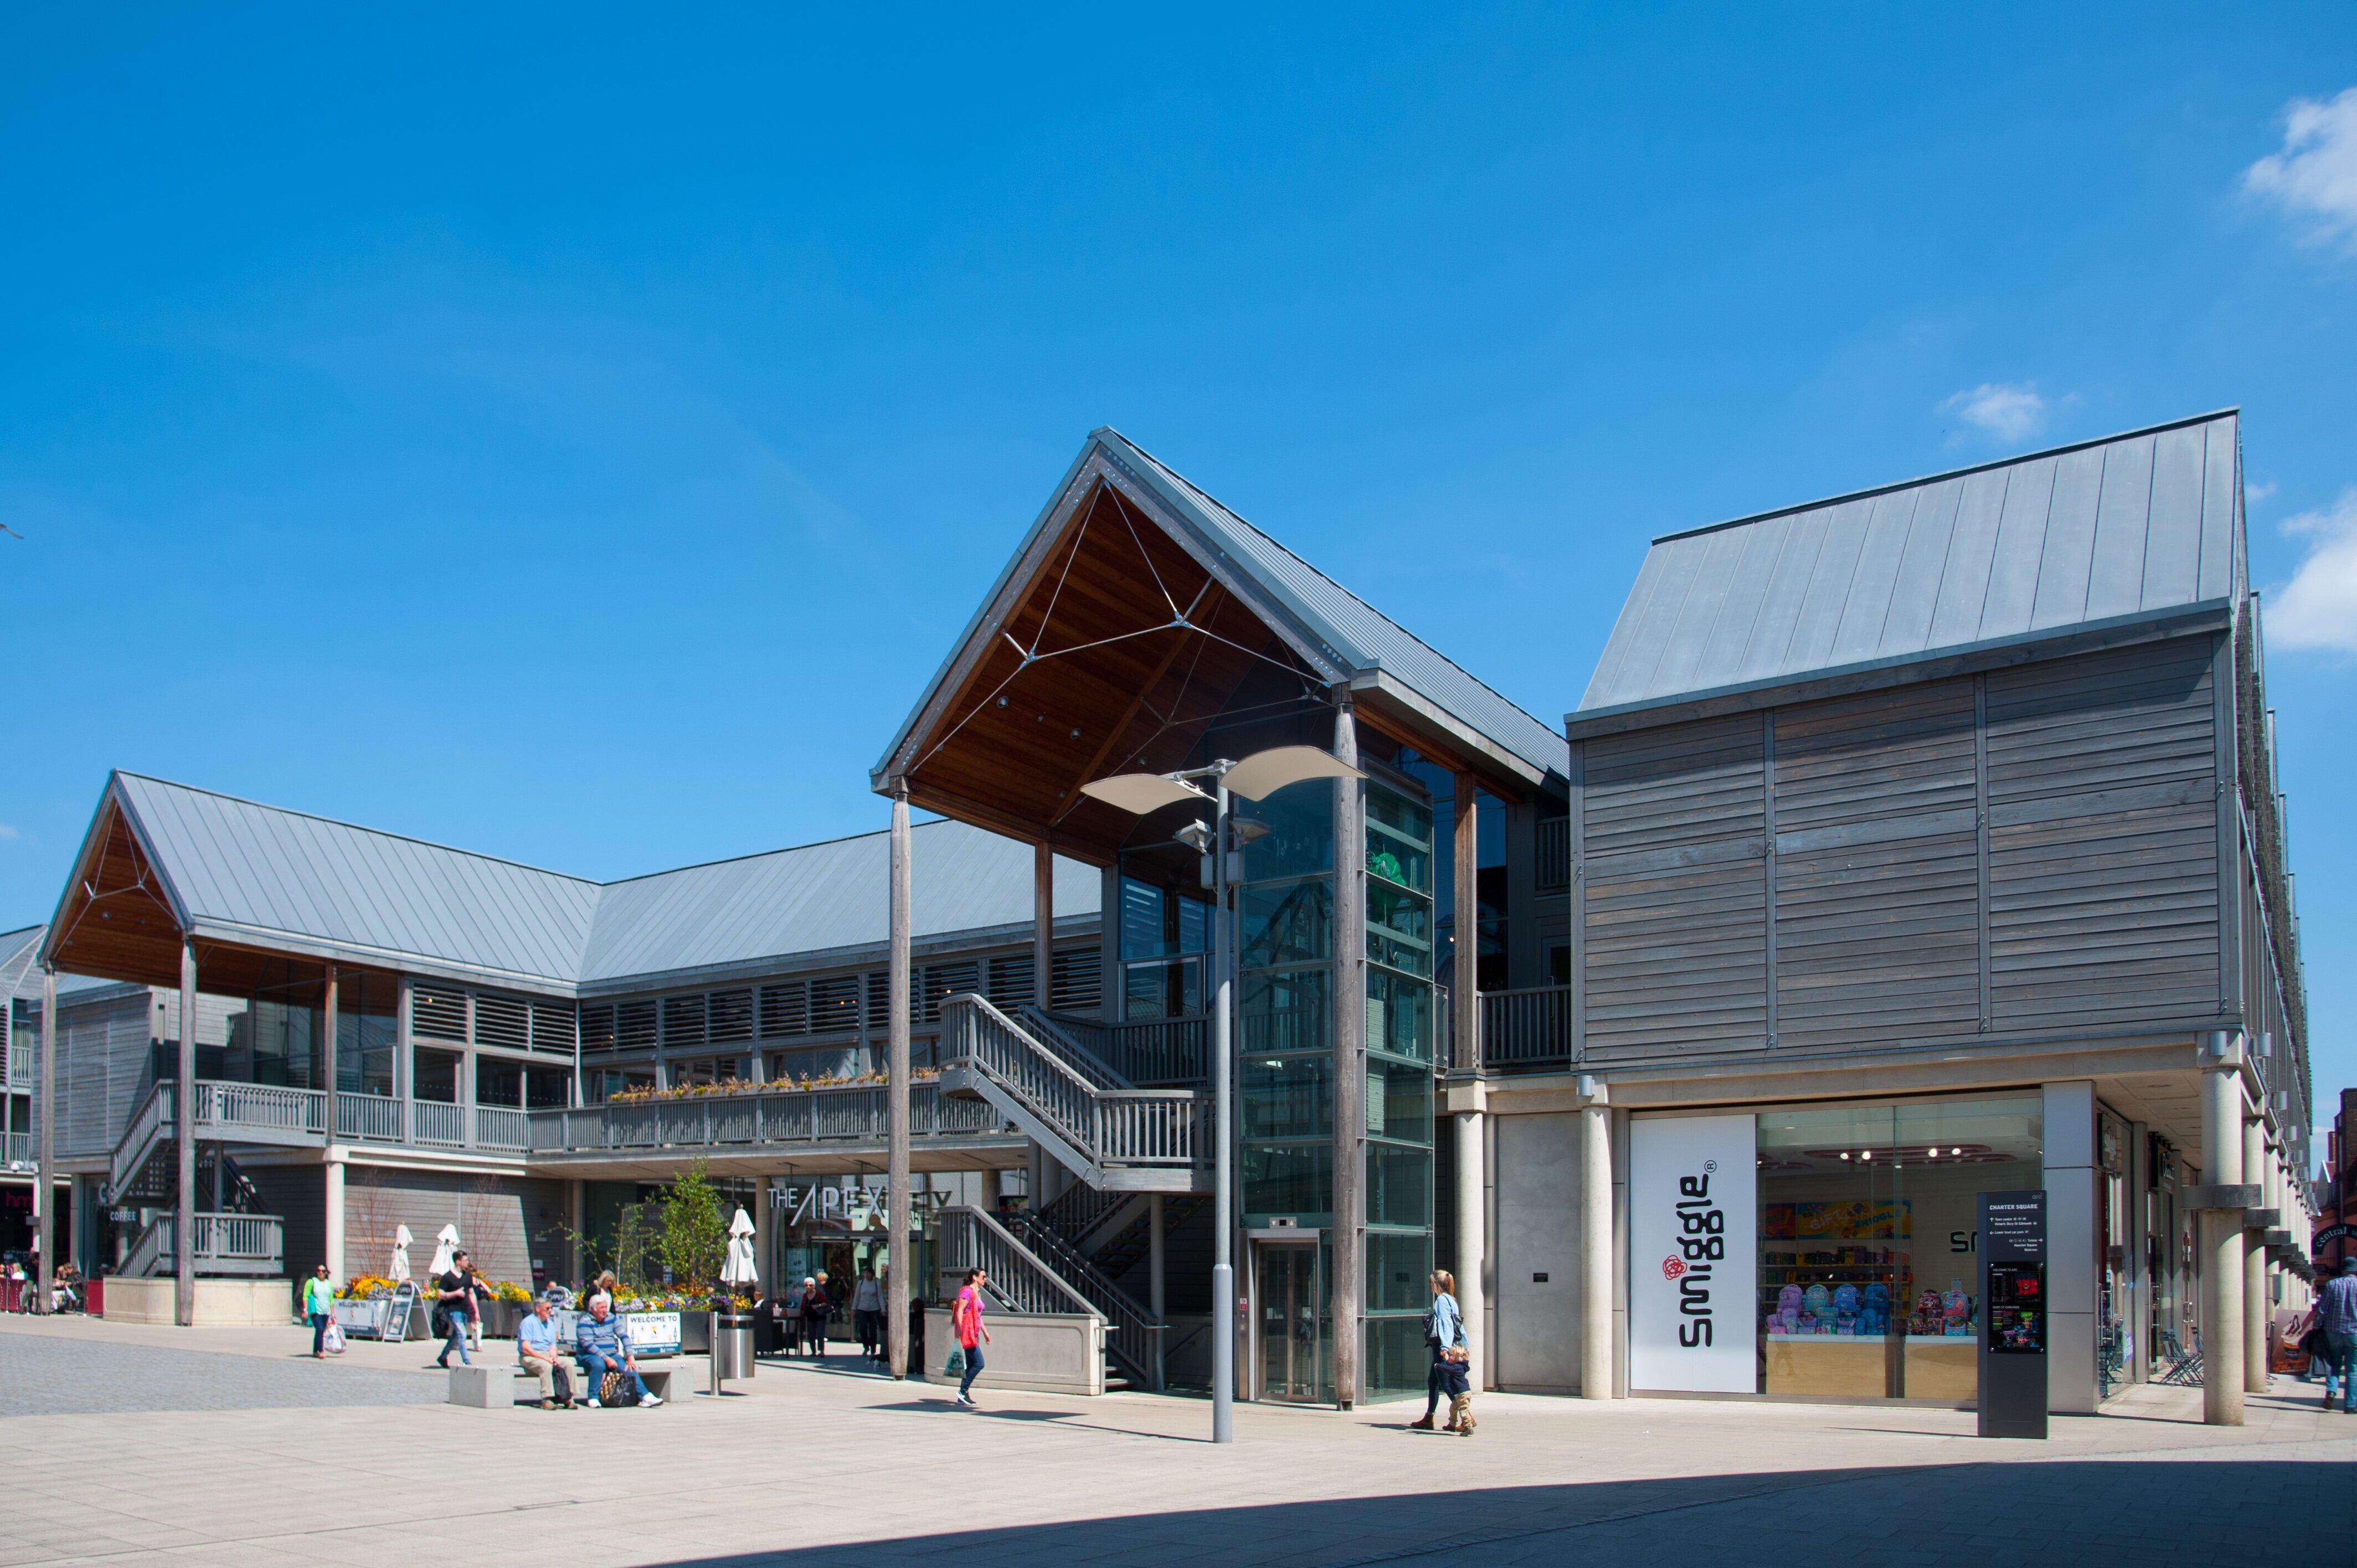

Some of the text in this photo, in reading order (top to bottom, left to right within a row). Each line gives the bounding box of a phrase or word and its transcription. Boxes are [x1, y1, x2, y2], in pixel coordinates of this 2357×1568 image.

[767, 1188, 798, 1208] THE
[790, 1182, 886, 1226] APEX
[110, 1211, 137, 1221] COFFEE
[2316, 1226, 2347, 1247] central
